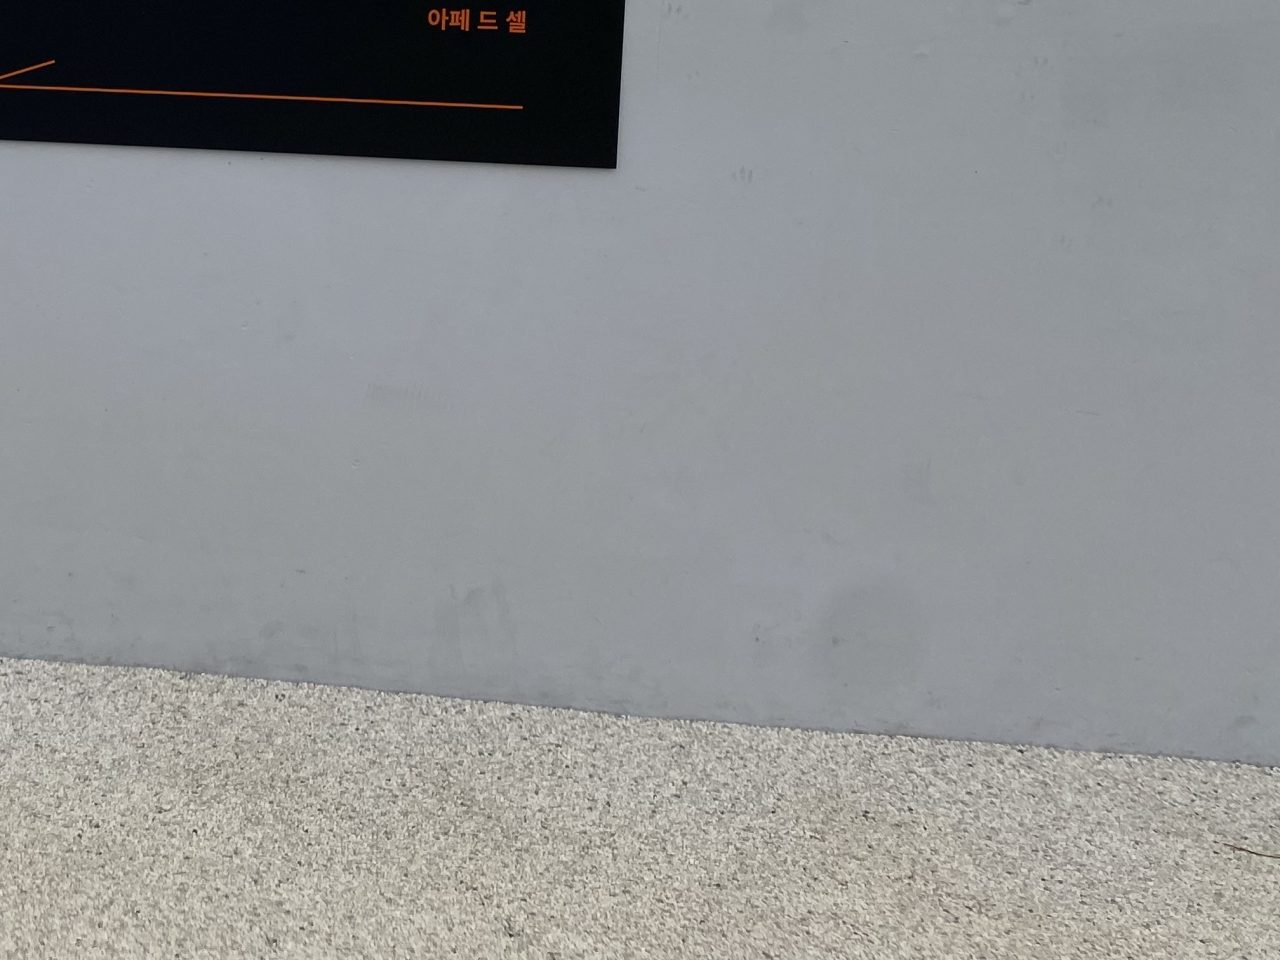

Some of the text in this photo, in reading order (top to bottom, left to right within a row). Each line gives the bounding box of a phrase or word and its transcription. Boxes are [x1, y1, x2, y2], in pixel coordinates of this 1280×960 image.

[427, 8, 527, 34] 아페 드 셀
